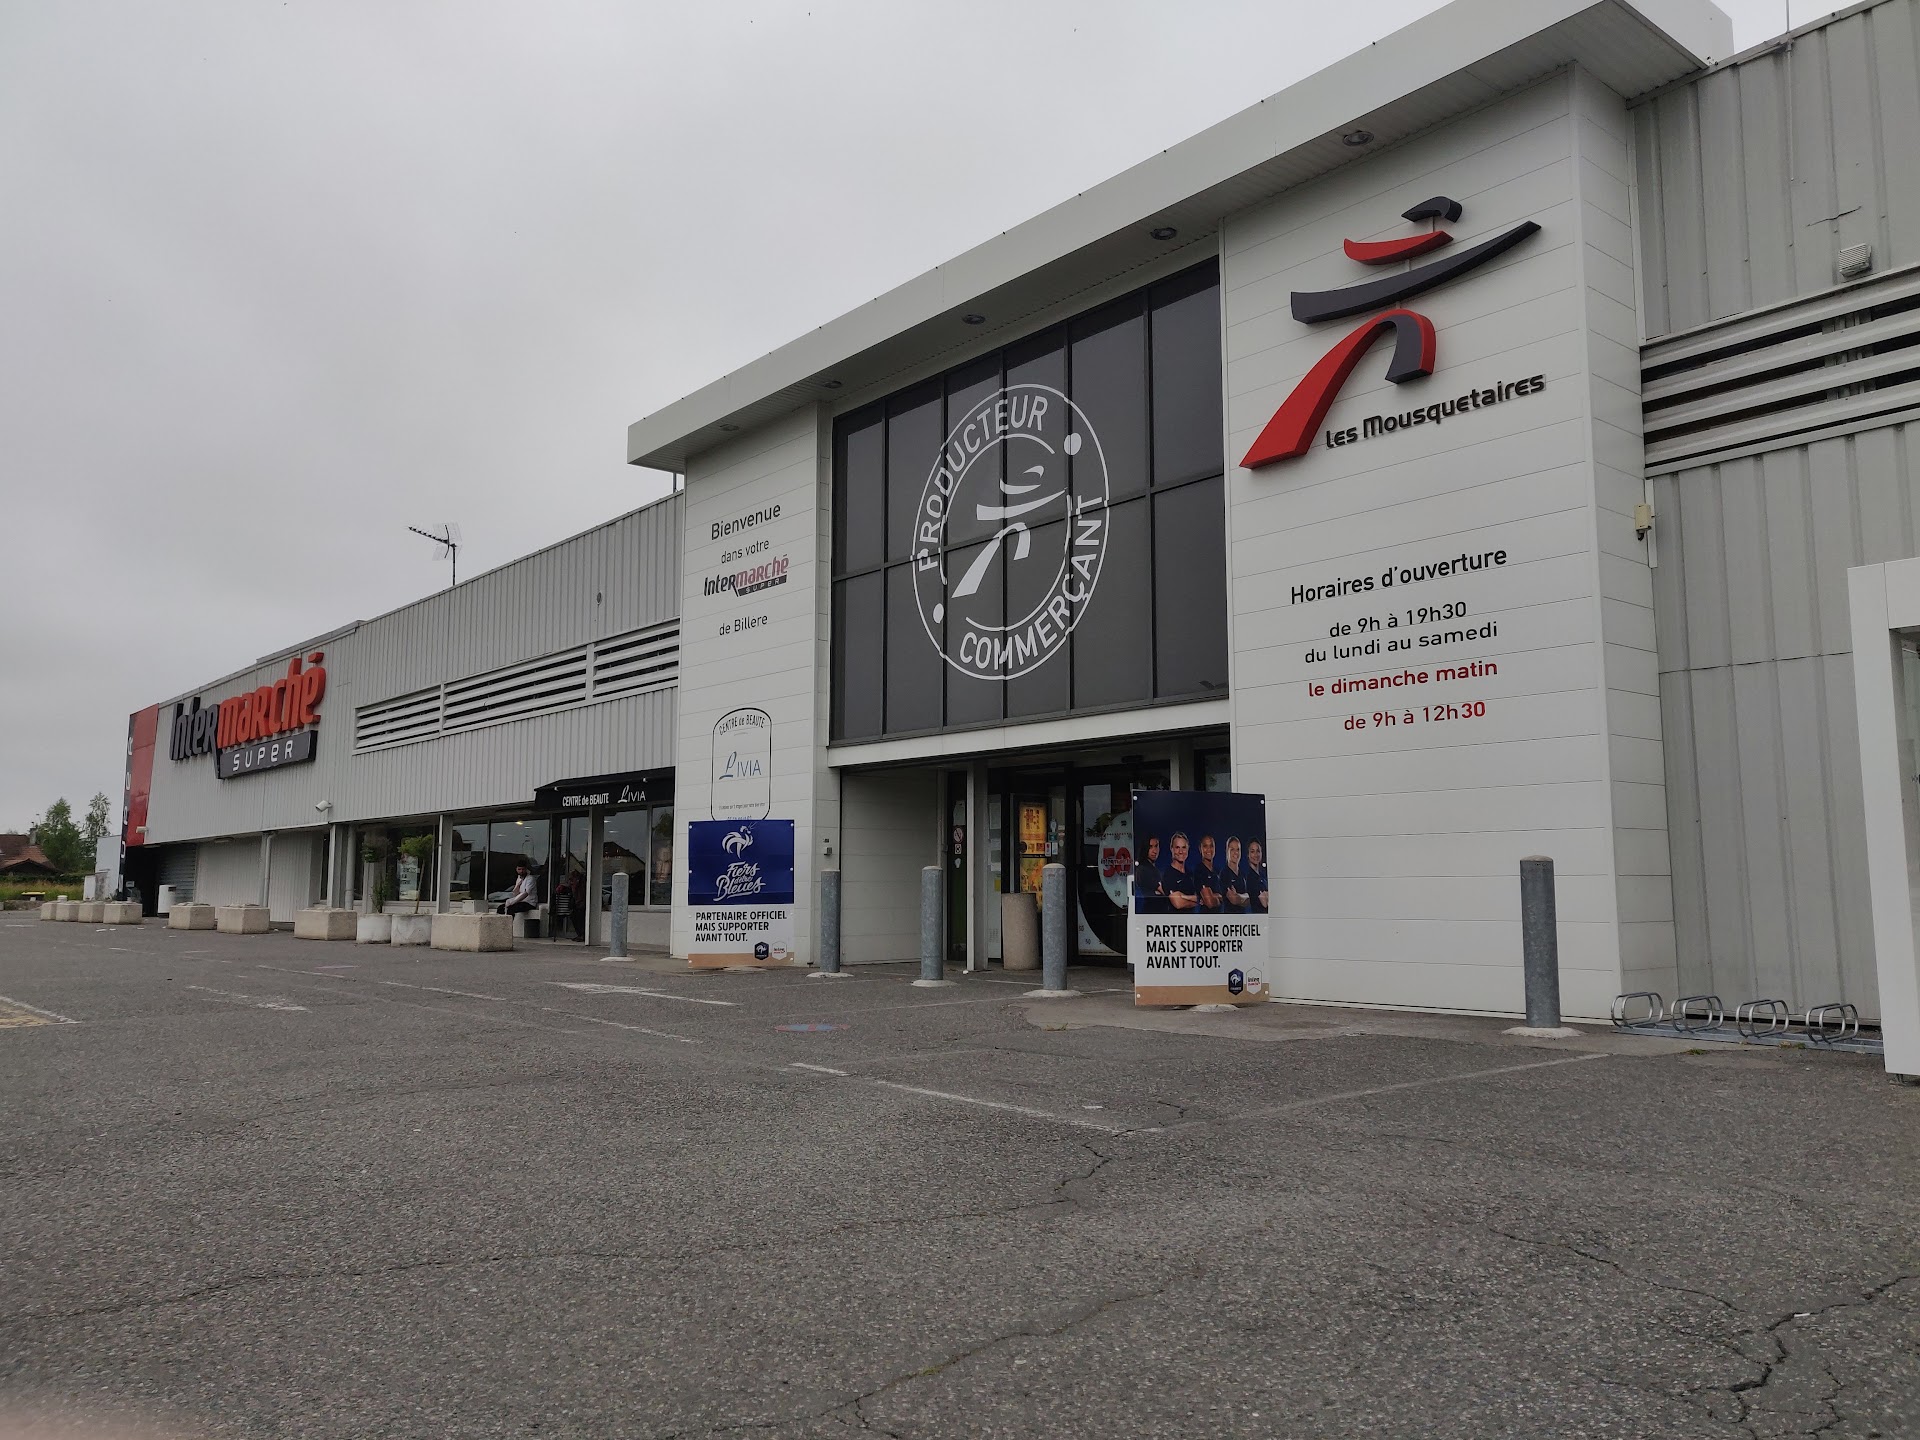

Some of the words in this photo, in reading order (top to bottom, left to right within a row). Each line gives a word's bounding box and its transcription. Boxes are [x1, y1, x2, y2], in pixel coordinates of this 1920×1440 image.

[1326, 427, 1358, 448] les
[1363, 374, 1545, 439] Mousquetaires
[918, 394, 1049, 572] PRODUCTEUR
[711, 504, 781, 540] Bienvenue
[721, 547, 742, 564] dans
[745, 539, 770, 556] votre
[745, 578, 780, 594] SUPER
[959, 494, 1103, 671] COMMERÇANT
[1291, 576, 1374, 605] Horaires
[1381, 549, 1507, 588] d'ouverture
[719, 623, 731, 636] de
[734, 615, 768, 632] Billère
[1329, 622, 1351, 638] de
[1357, 616, 1380, 633] 9h
[1387, 613, 1398, 628] à
[1406, 601, 1467, 625] 19h30
[1305, 648, 1326, 663] du
[1333, 639, 1380, 660] lundi
[1387, 638, 1411, 652] au
[1418, 621, 1497, 647] samedi
[1308, 682, 1325, 697] le
[1331, 670, 1429, 694] dimanche
[1436, 661, 1498, 682] matin
[719, 716, 738, 736] CENTRE
[739, 717, 745, 726] de
[1344, 715, 1366, 730] de
[1373, 711, 1396, 728] 9h
[1403, 710, 1414, 724] à
[1422, 701, 1486, 722] 12h30
[232, 740, 294, 772] SUPER
[562, 795, 581, 807] CENTRE
[581, 794, 589, 805] de
[727, 860, 761, 878] Fiers
[713, 875, 767, 901] Bleues
[695, 911, 748, 921] PARTENAIRE
[750, 910, 787, 920] OFFICIEL
[695, 922, 717, 932] MAIS
[718, 921, 770, 931] SUPPORTER
[695, 933, 722, 942] AVANT
[724, 933, 748, 942] TOUT.
[1146, 924, 1219, 938] PARTENAIRE
[1222, 924, 1261, 937] OFFICIEL
[1146, 940, 1177, 953] MAIS
[1180, 940, 1243, 953] SUPPORTER
[1146, 956, 1187, 969] AVANT
[1189, 956, 1221, 969] TOUT.
